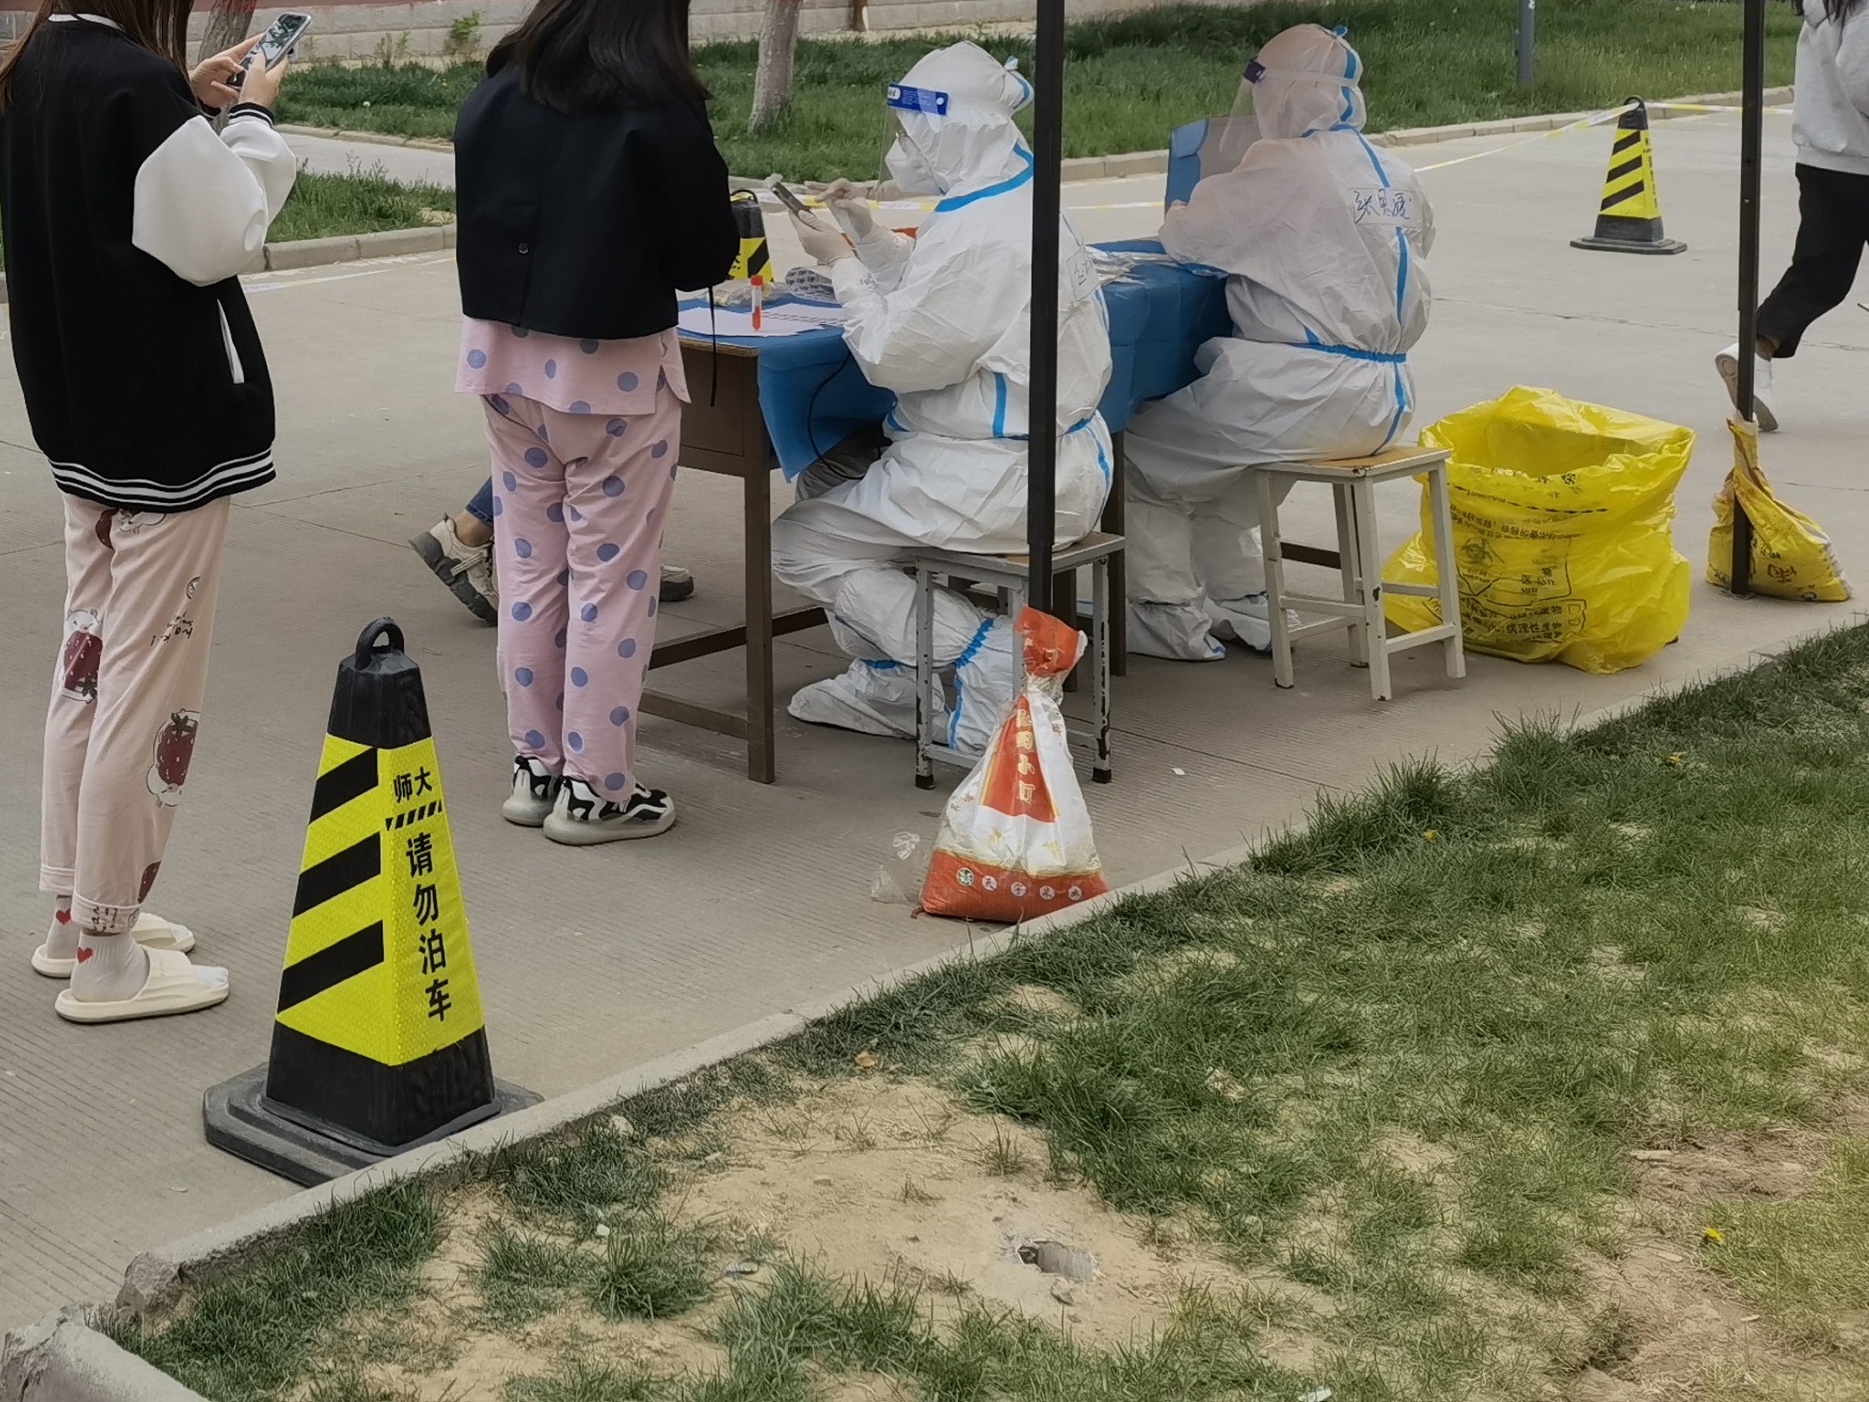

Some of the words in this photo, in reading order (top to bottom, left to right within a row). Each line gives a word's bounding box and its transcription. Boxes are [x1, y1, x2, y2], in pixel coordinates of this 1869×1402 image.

[393, 766, 433, 804] 师大
[405, 832, 452, 1022] 请勿泊车
